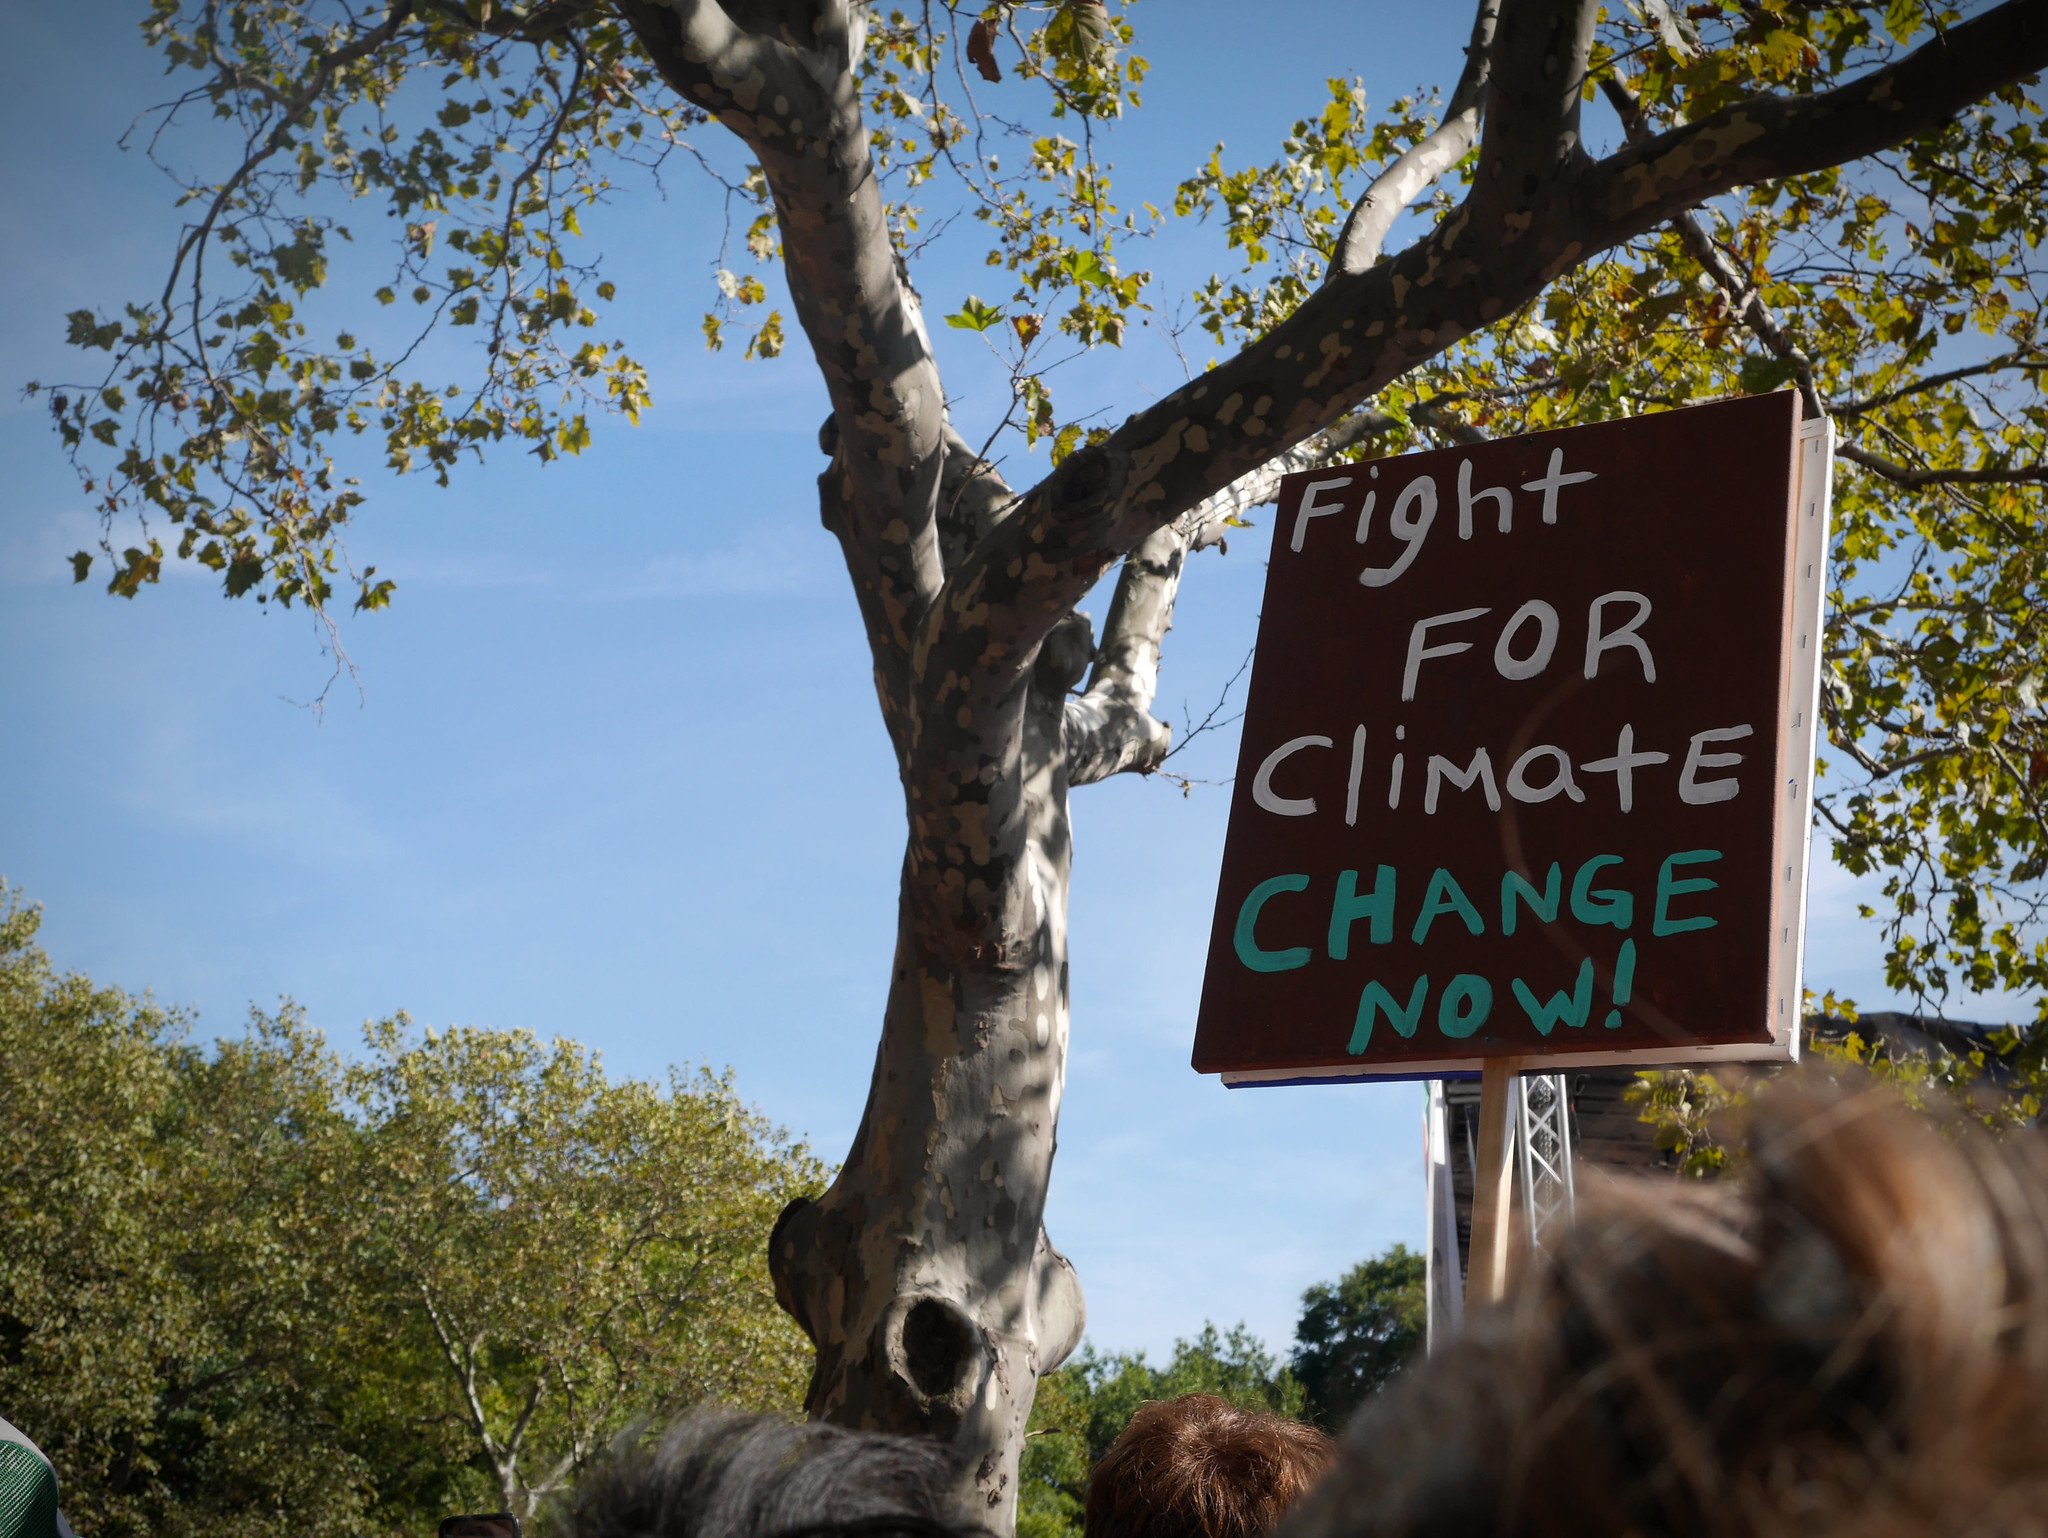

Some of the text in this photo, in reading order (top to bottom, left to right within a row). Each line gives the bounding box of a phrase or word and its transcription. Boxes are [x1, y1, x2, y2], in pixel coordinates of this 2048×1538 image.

[1291, 447, 1598, 588] Fight
[1402, 590, 1657, 702] FOR
[1234, 849, 1723, 972] CHANGE
[1349, 938, 1636, 1054] NOW!
